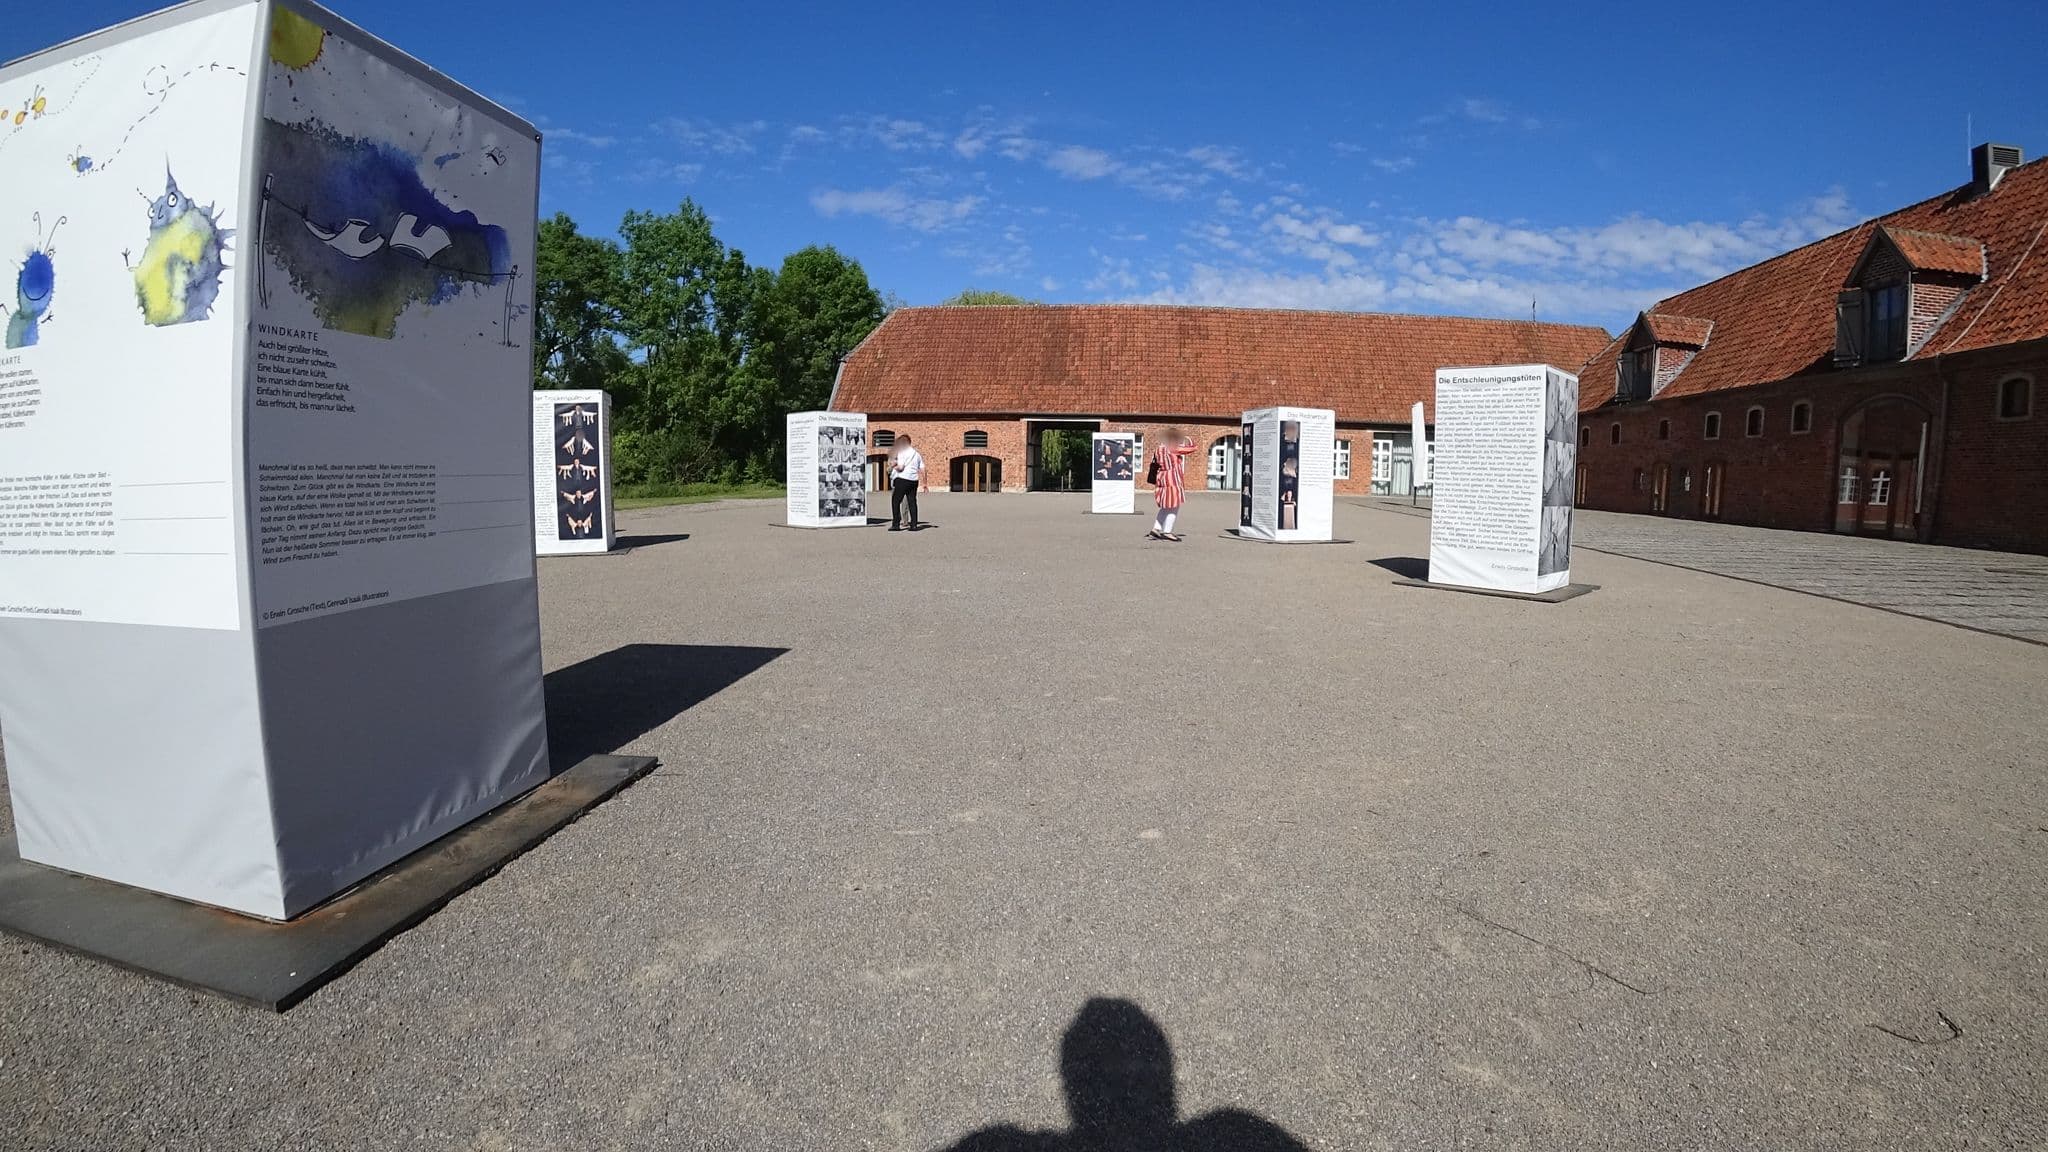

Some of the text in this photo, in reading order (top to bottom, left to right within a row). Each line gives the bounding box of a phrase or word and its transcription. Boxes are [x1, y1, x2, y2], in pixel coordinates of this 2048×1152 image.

[258, 324, 319, 341] WINDKARTE
[0, 355, 20, 366] KARTE
[1452, 375, 1541, 384] Entschleunigungstüten
